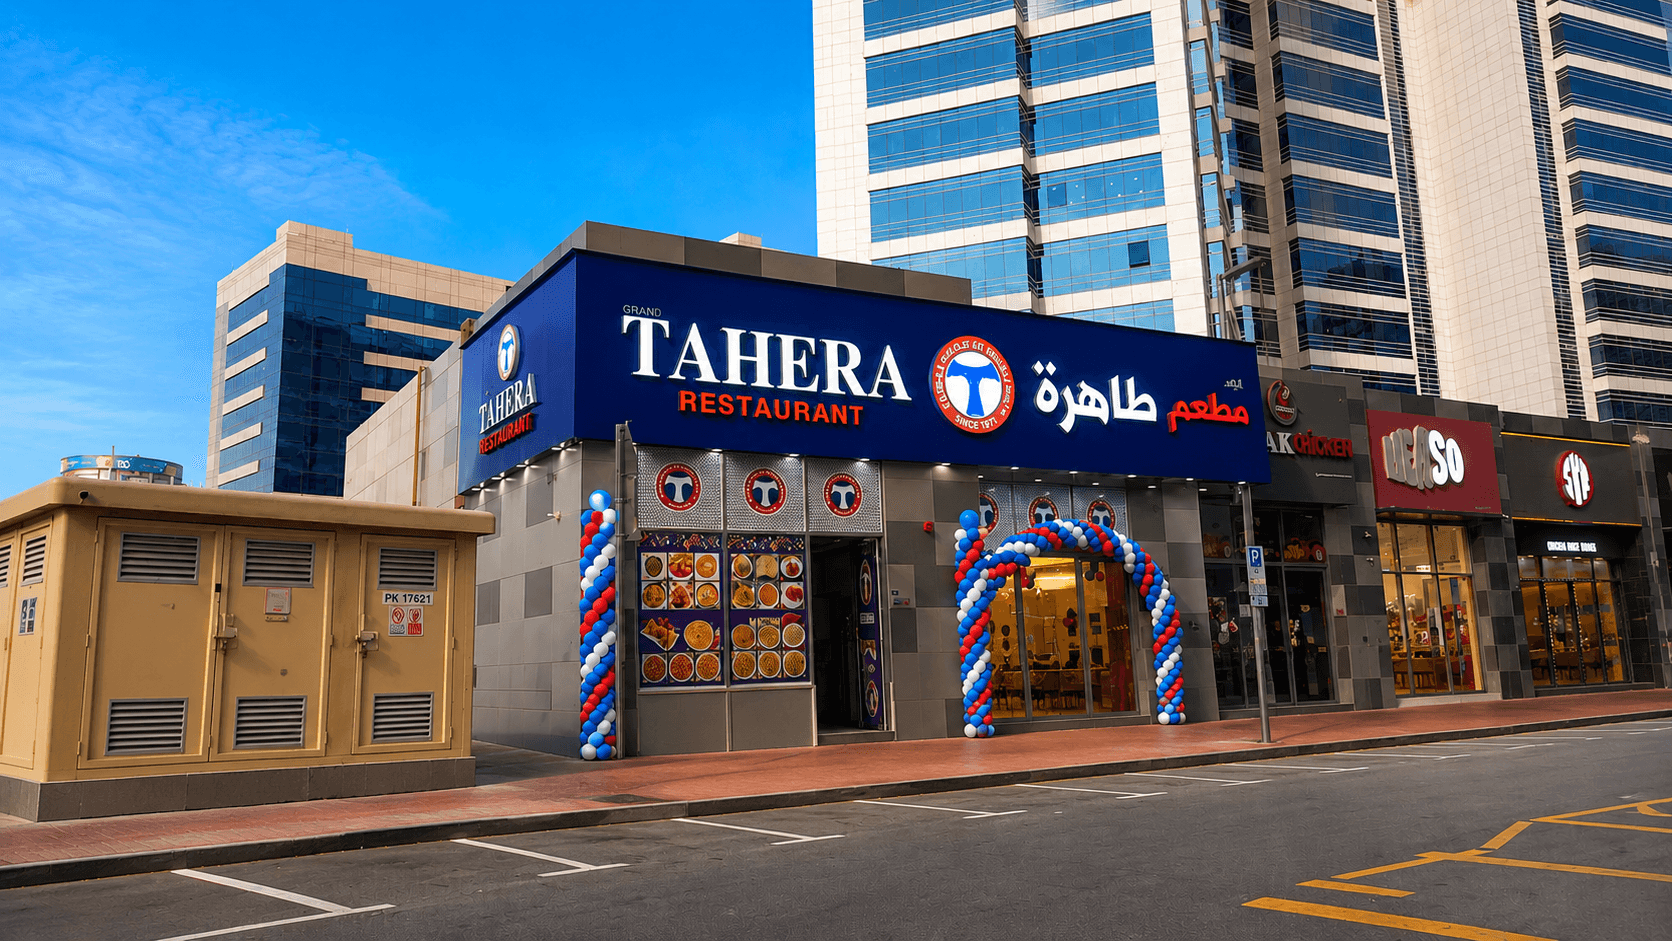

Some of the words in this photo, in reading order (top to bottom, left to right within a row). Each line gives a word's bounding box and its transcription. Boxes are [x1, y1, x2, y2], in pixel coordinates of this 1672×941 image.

[622, 304, 662, 317] GRAND
[621, 314, 912, 402] TAHERA
[479, 372, 537, 434] TAHERA
[678, 390, 864, 425] RESTAURANT
[1031, 360, 1157, 434] طاهرة
[1166, 393, 1249, 433] مطعم
[479, 412, 534, 455] RESTAURANT
[954, 414, 979, 430] SINCE
[384, 593, 399, 603] PK
[402, 593, 431, 604] 17621
